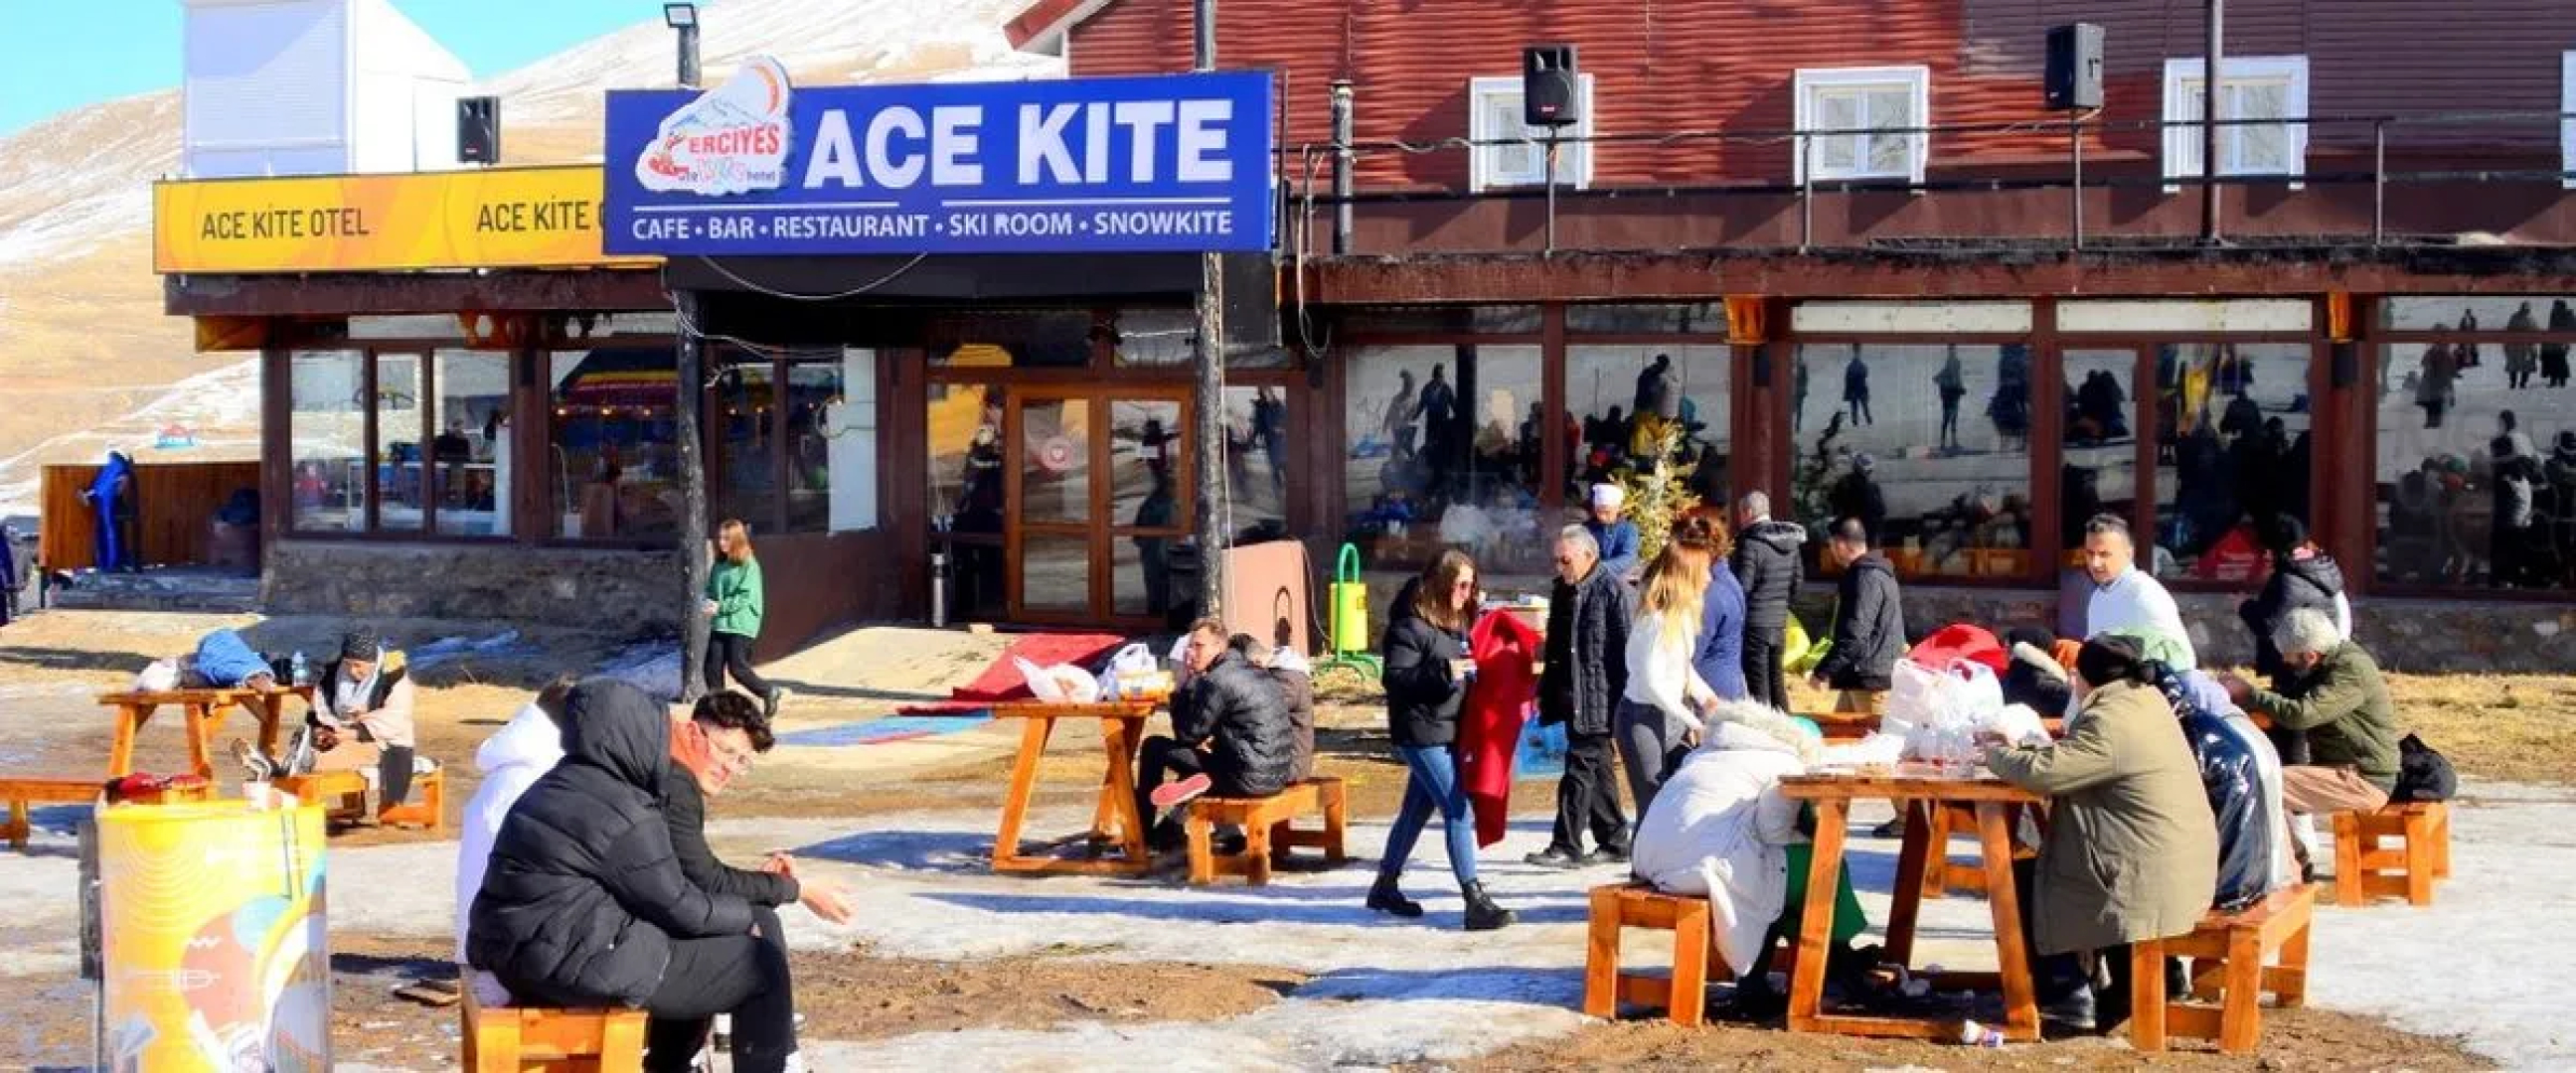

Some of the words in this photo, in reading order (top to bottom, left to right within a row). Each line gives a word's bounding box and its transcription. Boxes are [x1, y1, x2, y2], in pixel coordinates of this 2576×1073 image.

[803, 105, 983, 189] ACE
[1018, 100, 1232, 185] KITE
[202, 212, 245, 239] ACE
[252, 203, 303, 238] KİTE
[309, 208, 370, 236] OTEL
[476, 203, 527, 231] ACE
[534, 194, 590, 230] KİTE
[633, 218, 690, 239] CAFE
[708, 216, 754, 238] BAR
[773, 214, 930, 237] RESTAURANT
[949, 214, 987, 235] SKI
[995, 213, 1072, 234] ROOM
[1093, 210, 1232, 234] SNOWKITE
